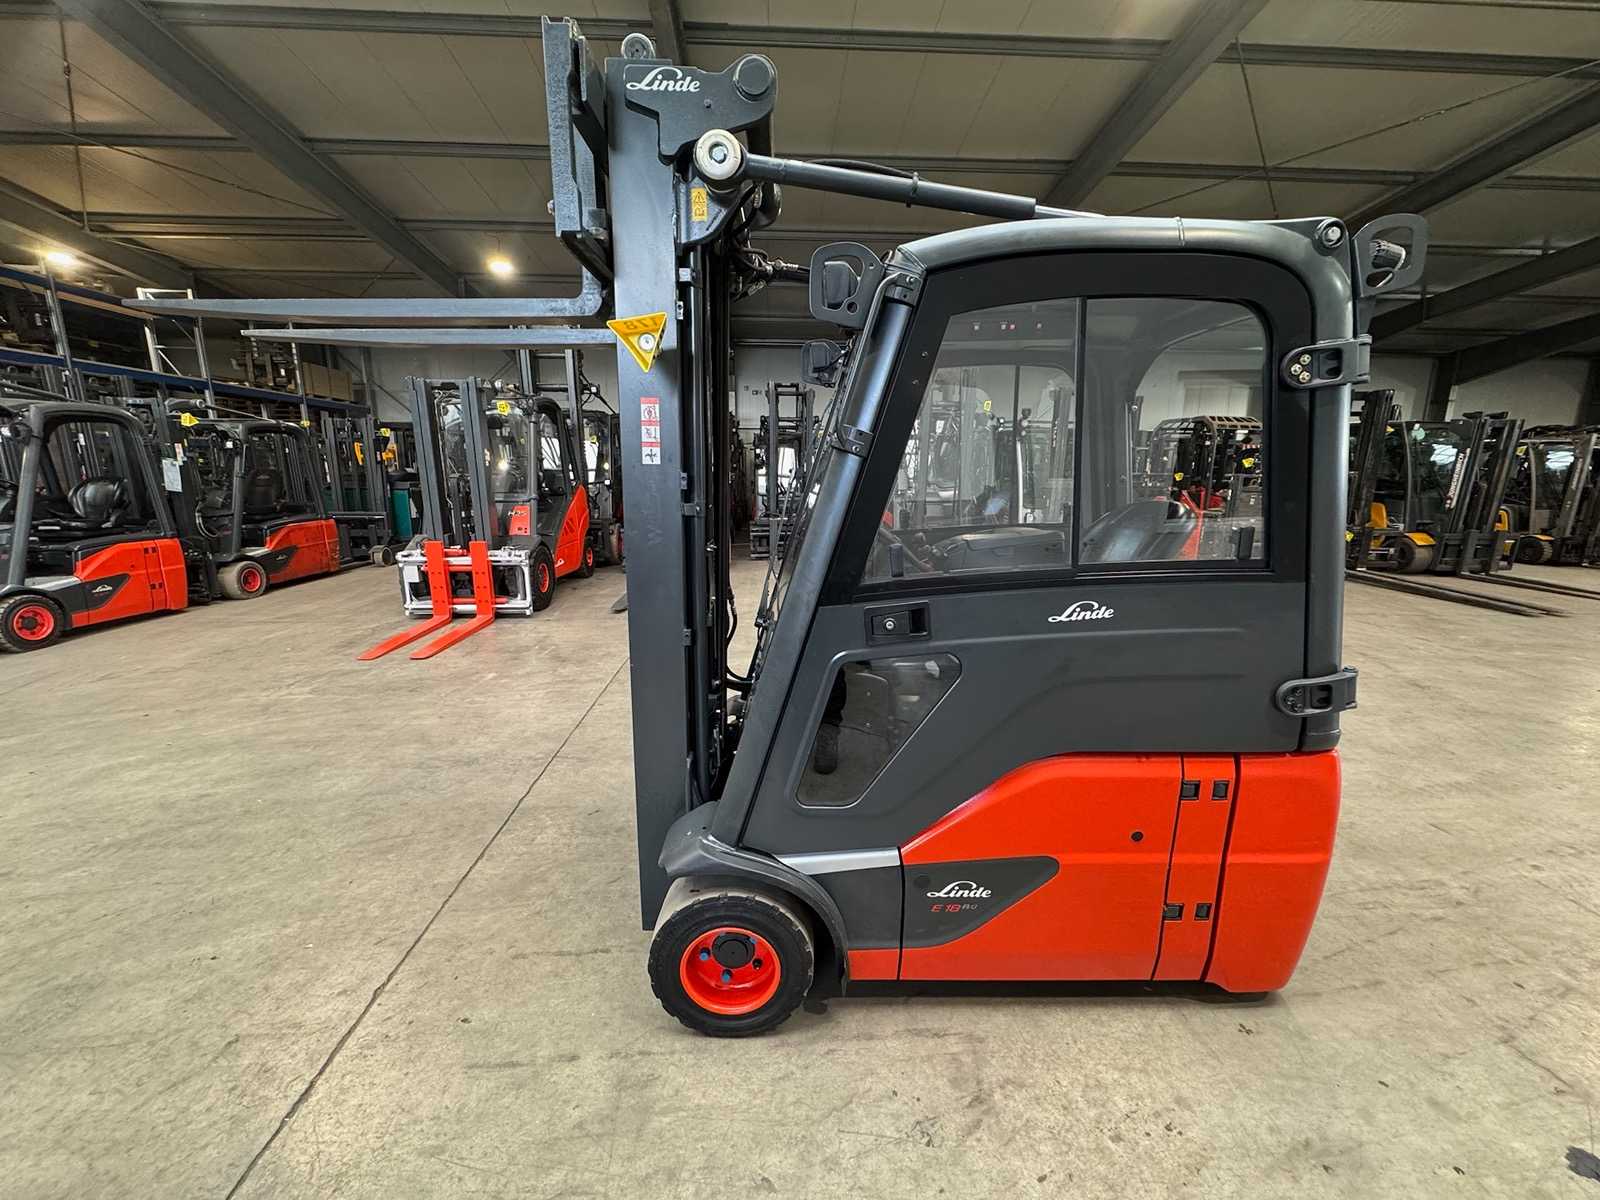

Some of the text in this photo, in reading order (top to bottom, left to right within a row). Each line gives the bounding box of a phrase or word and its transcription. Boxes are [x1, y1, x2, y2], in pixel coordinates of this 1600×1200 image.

[626, 66, 700, 92] Linde
[1047, 600, 1115, 623] Linde
[926, 880, 992, 898] Linde
[931, 903, 942, 913] E
